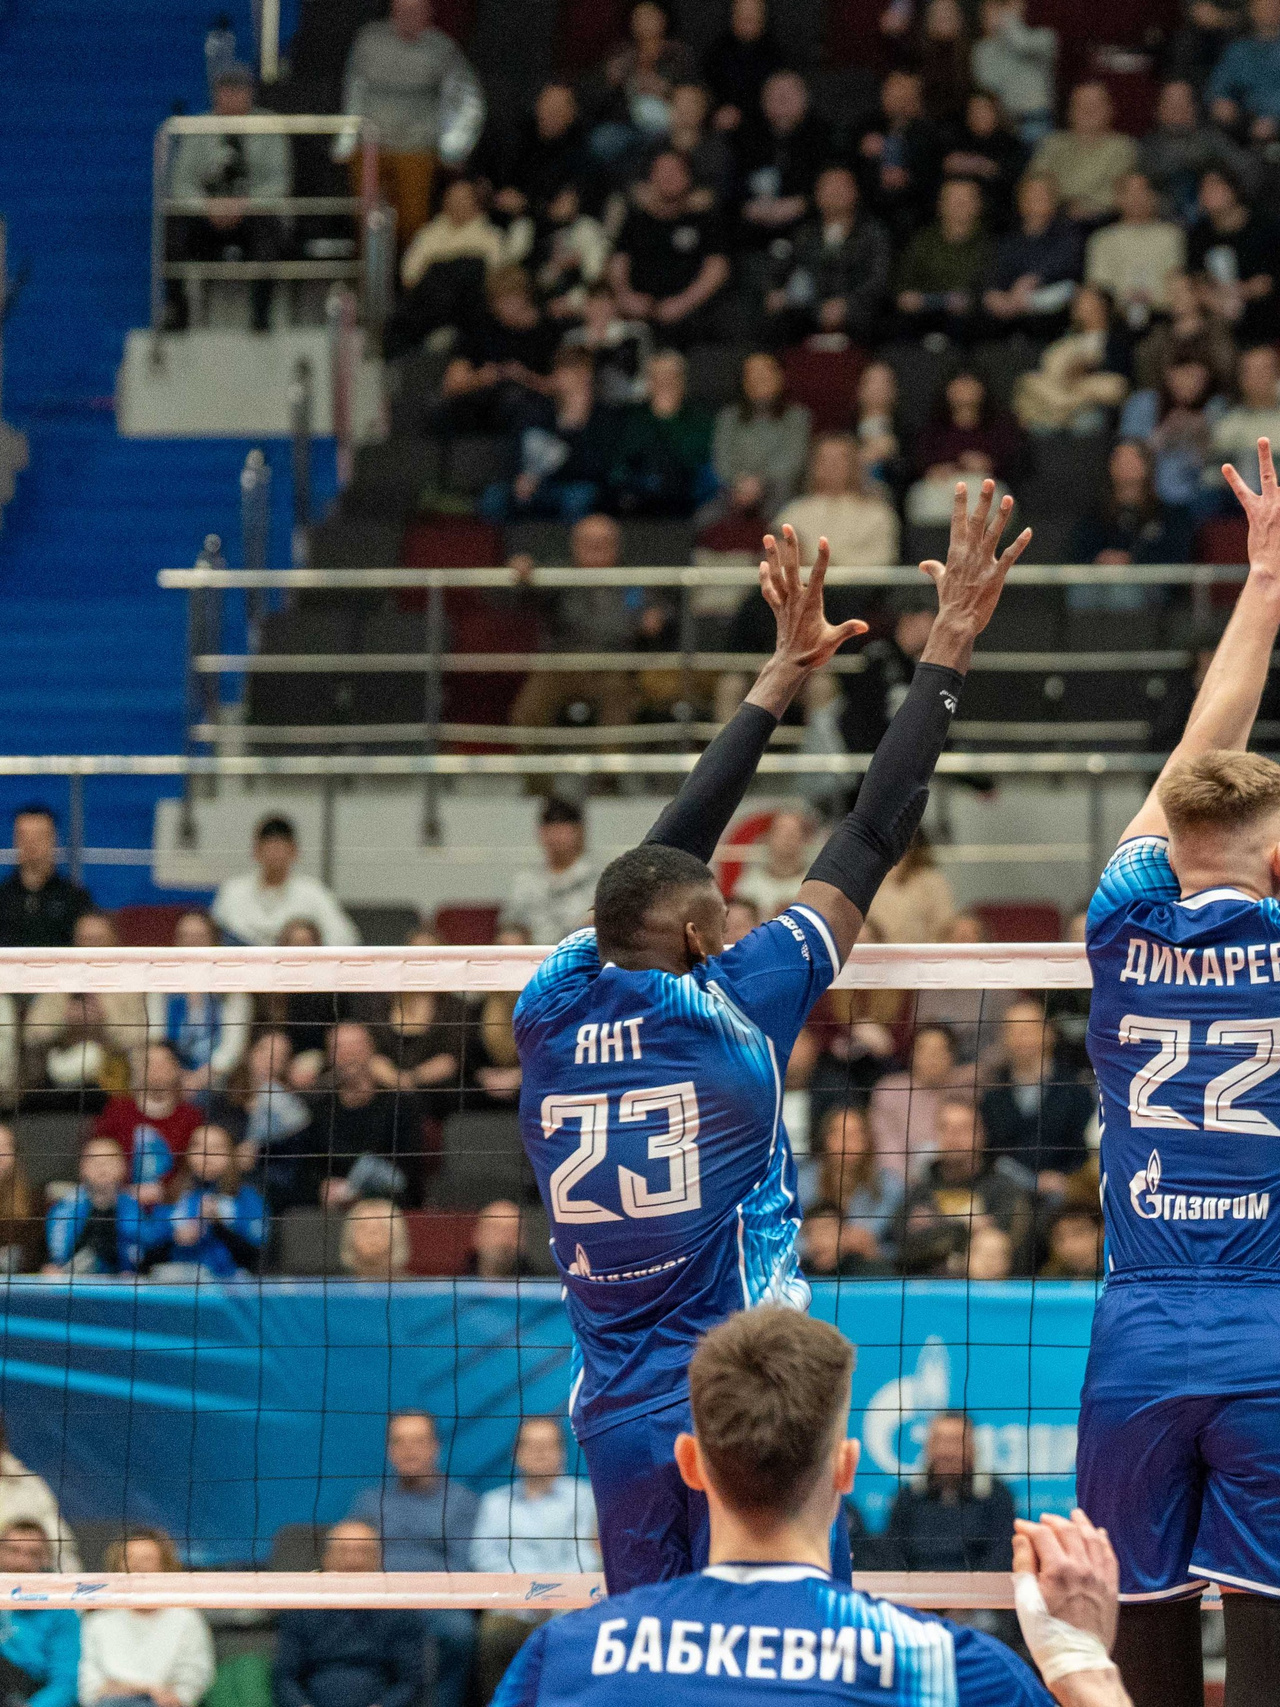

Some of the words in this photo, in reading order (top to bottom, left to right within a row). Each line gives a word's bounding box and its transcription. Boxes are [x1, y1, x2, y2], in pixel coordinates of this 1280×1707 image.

[574, 1016, 644, 1064] ЯНТ
[540, 1081, 701, 1224] 23
[1162, 1193, 1270, 1220] ГАЗПРОМ
[591, 1616, 895, 1689] БАБКЕВИЧ
